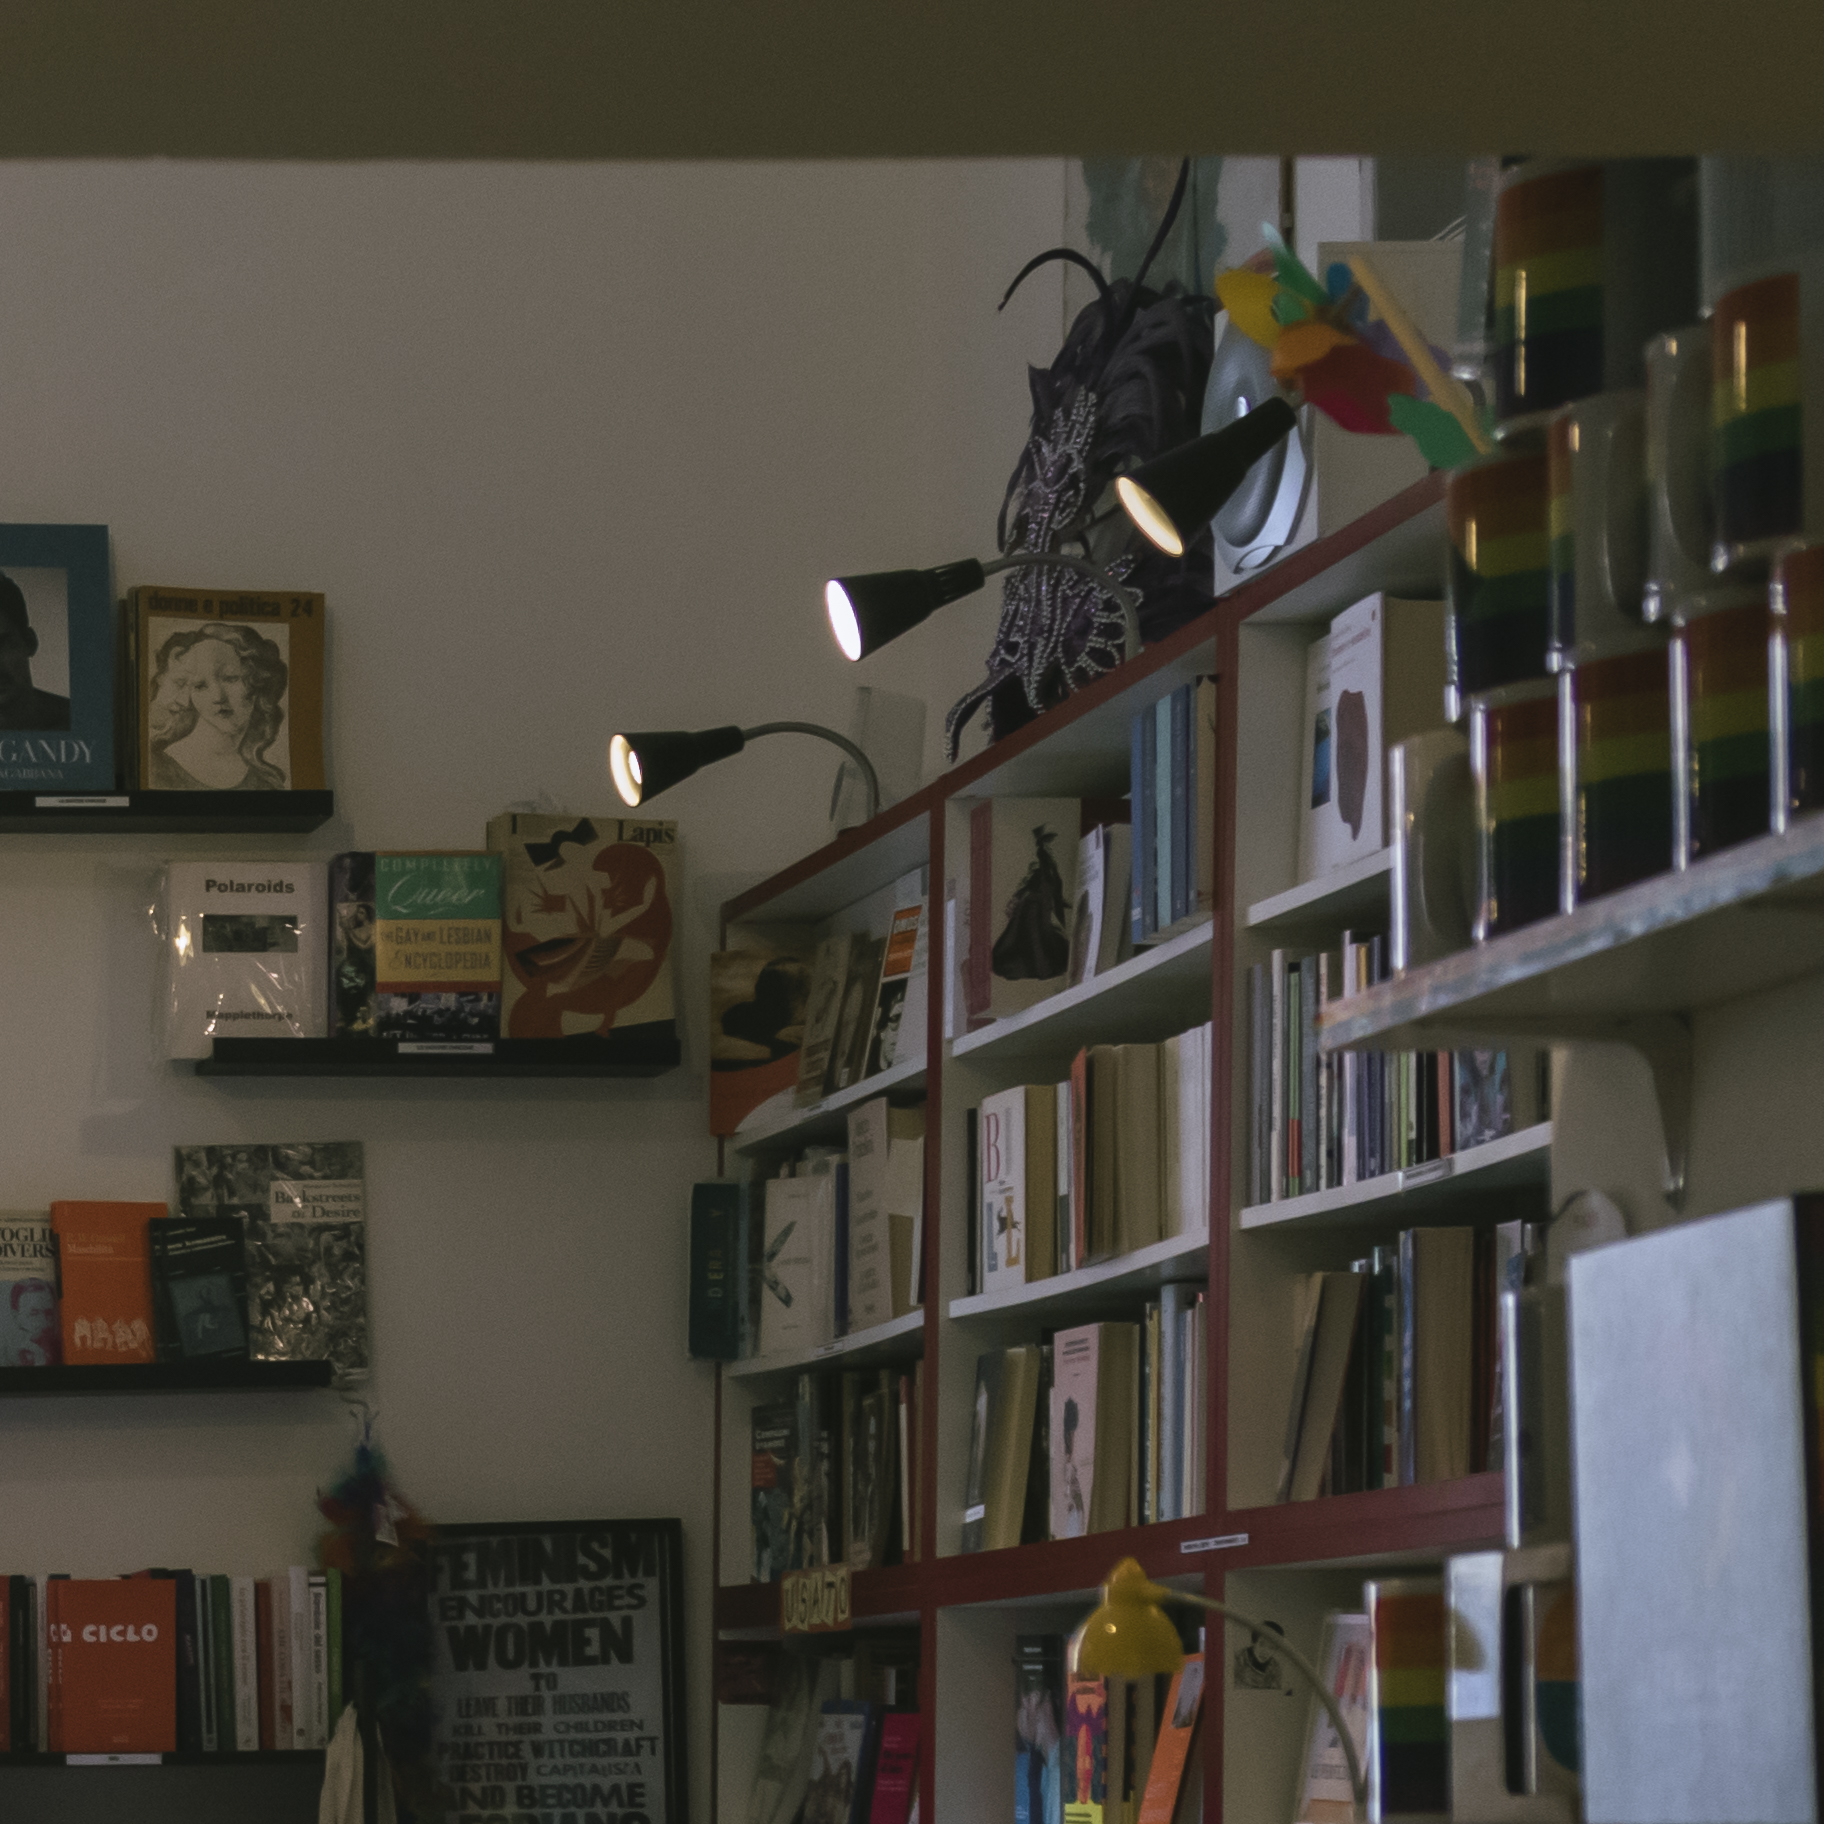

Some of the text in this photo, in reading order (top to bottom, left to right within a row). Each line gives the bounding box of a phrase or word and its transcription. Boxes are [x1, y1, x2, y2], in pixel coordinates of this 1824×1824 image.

[290, 598, 314, 618] 24
[616, 819, 675, 848] Lapis
[380, 858, 493, 872] COMPLETELY
[205, 880, 296, 894] Polaroids
[387, 871, 486, 914] Queer
[395, 926, 419, 945] GAY
[438, 926, 493, 945] LESBIAN
[388, 949, 492, 970] ENCYCLOPEDIA
[205, 1010, 295, 1022] Mapplethorpe
[275, 1190, 362, 1204] Bakstreets
[312, 1205, 361, 1218] Desire
[438, 1583, 648, 1621] ENCOURAGES
[81, 1623, 159, 1643] CICLO
[446, 1615, 635, 1672] WOMEN
[529, 1672, 559, 1692] TO
[457, 1692, 632, 1718] LEAVE THEIR HUSBANDS
[453, 1719, 645, 1737] KILL THEIR CHILDREN
[437, 1736, 660, 1761] PRACTICE WITCHCRAFT
[449, 1762, 530, 1783] DESTROY
[515, 1783, 646, 1810] BECOME
